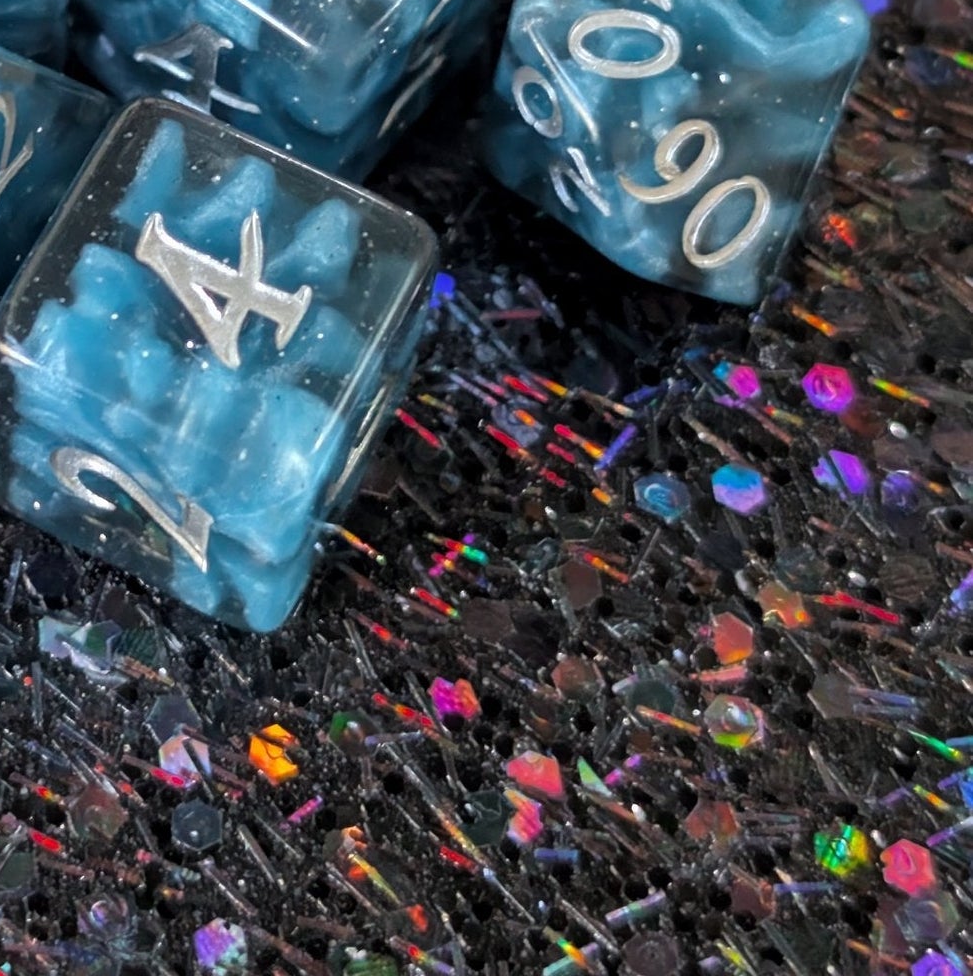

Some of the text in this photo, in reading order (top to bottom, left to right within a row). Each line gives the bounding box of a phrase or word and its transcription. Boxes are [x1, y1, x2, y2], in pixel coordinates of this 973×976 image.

[618, 118, 772, 270] 90
[135, 208, 313, 370] 4
[50, 446, 215, 573] 2
